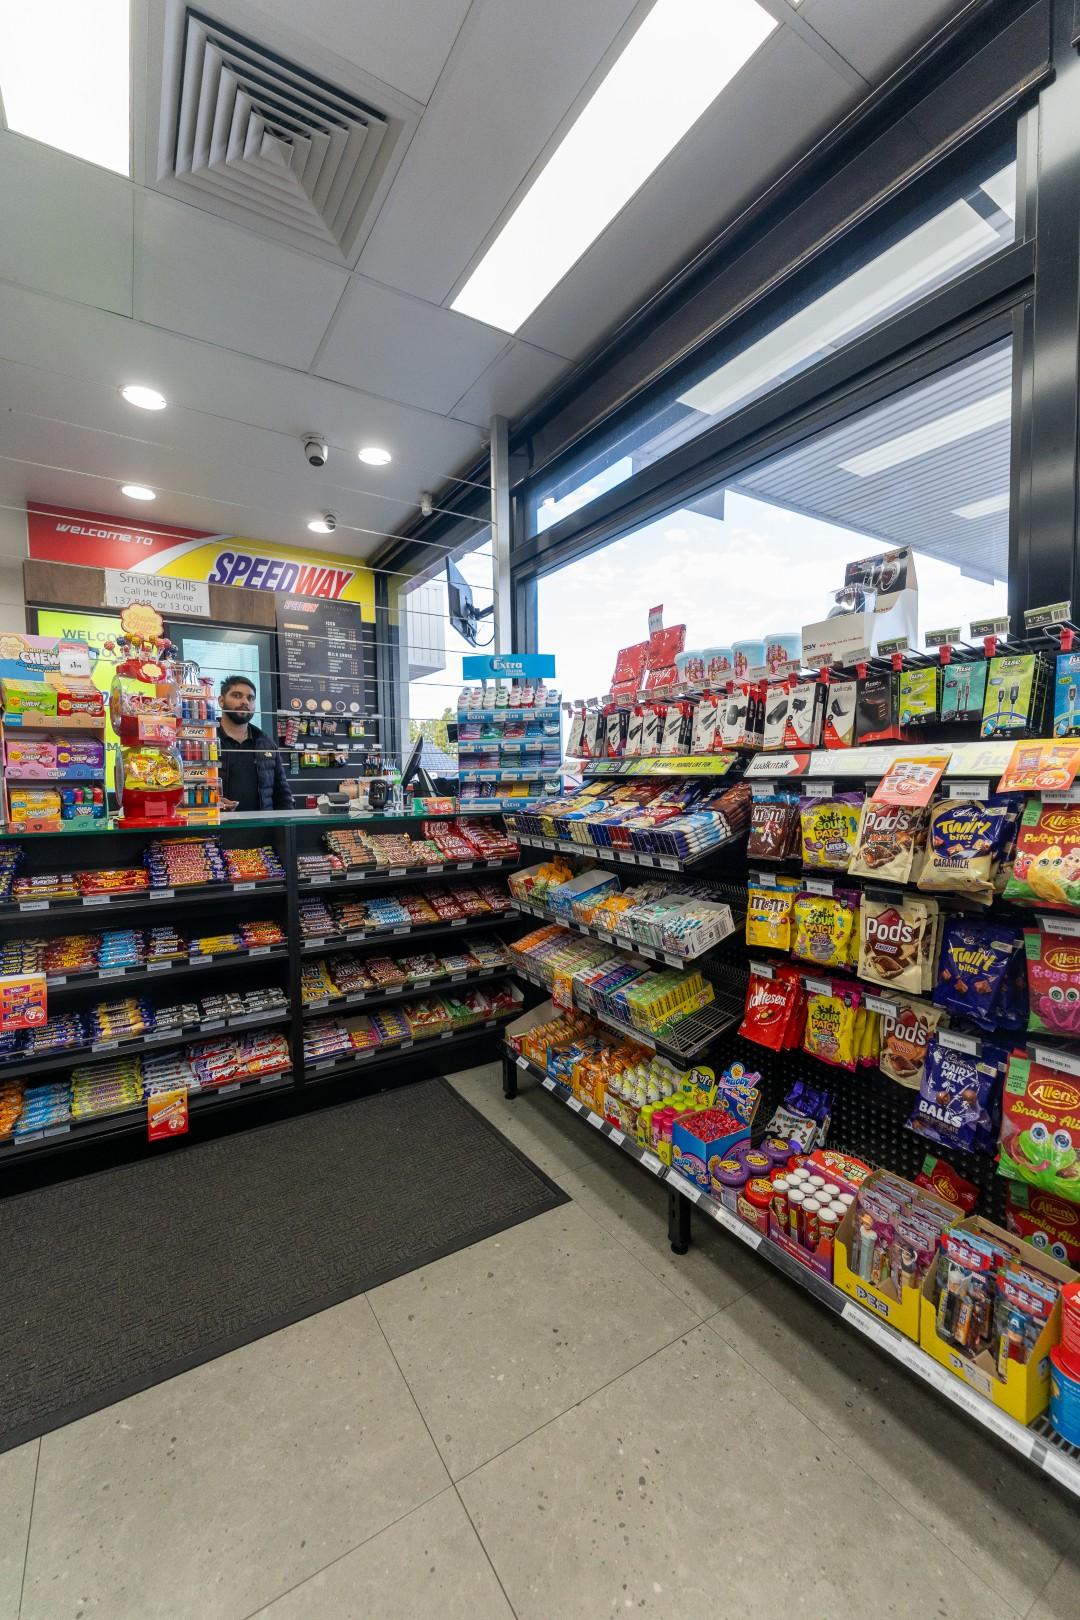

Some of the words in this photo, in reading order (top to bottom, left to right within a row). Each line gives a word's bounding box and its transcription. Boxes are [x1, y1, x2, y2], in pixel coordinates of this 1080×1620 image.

[119, 572, 172, 590] Smoking
[176, 579, 197, 592] kills
[209, 552, 353, 599] SPEEDWAY
[123, 586, 141, 596] Call
[143, 588, 158, 597] the
[160, 590, 194, 602] Quitline
[114, 595, 130, 605] 137
[170, 602, 180, 610] 13
[182, 604, 203, 613] QUIT
[815, 818, 847, 830] SOUR
[936, 819, 991, 835] Twirl
[815, 829, 849, 841] PATCH
[934, 858, 970, 869] CARAMILK
[805, 923, 835, 936] PATCH
[949, 947, 998, 971] Twirl
[812, 1018, 841, 1032] PATCH
[940, 1070, 967, 1086] MILK
[941, 1061, 975, 1078] DAIRY
[1033, 1085, 1079, 1105] Allen's
[919, 1100, 963, 1128] BALLS
[1010, 1100, 1057, 1123] Snakes
[948, 1239, 983, 1267] PEZ
[856, 1283, 889, 1317] PEZ
[1004, 1281, 1044, 1314] PEZ
